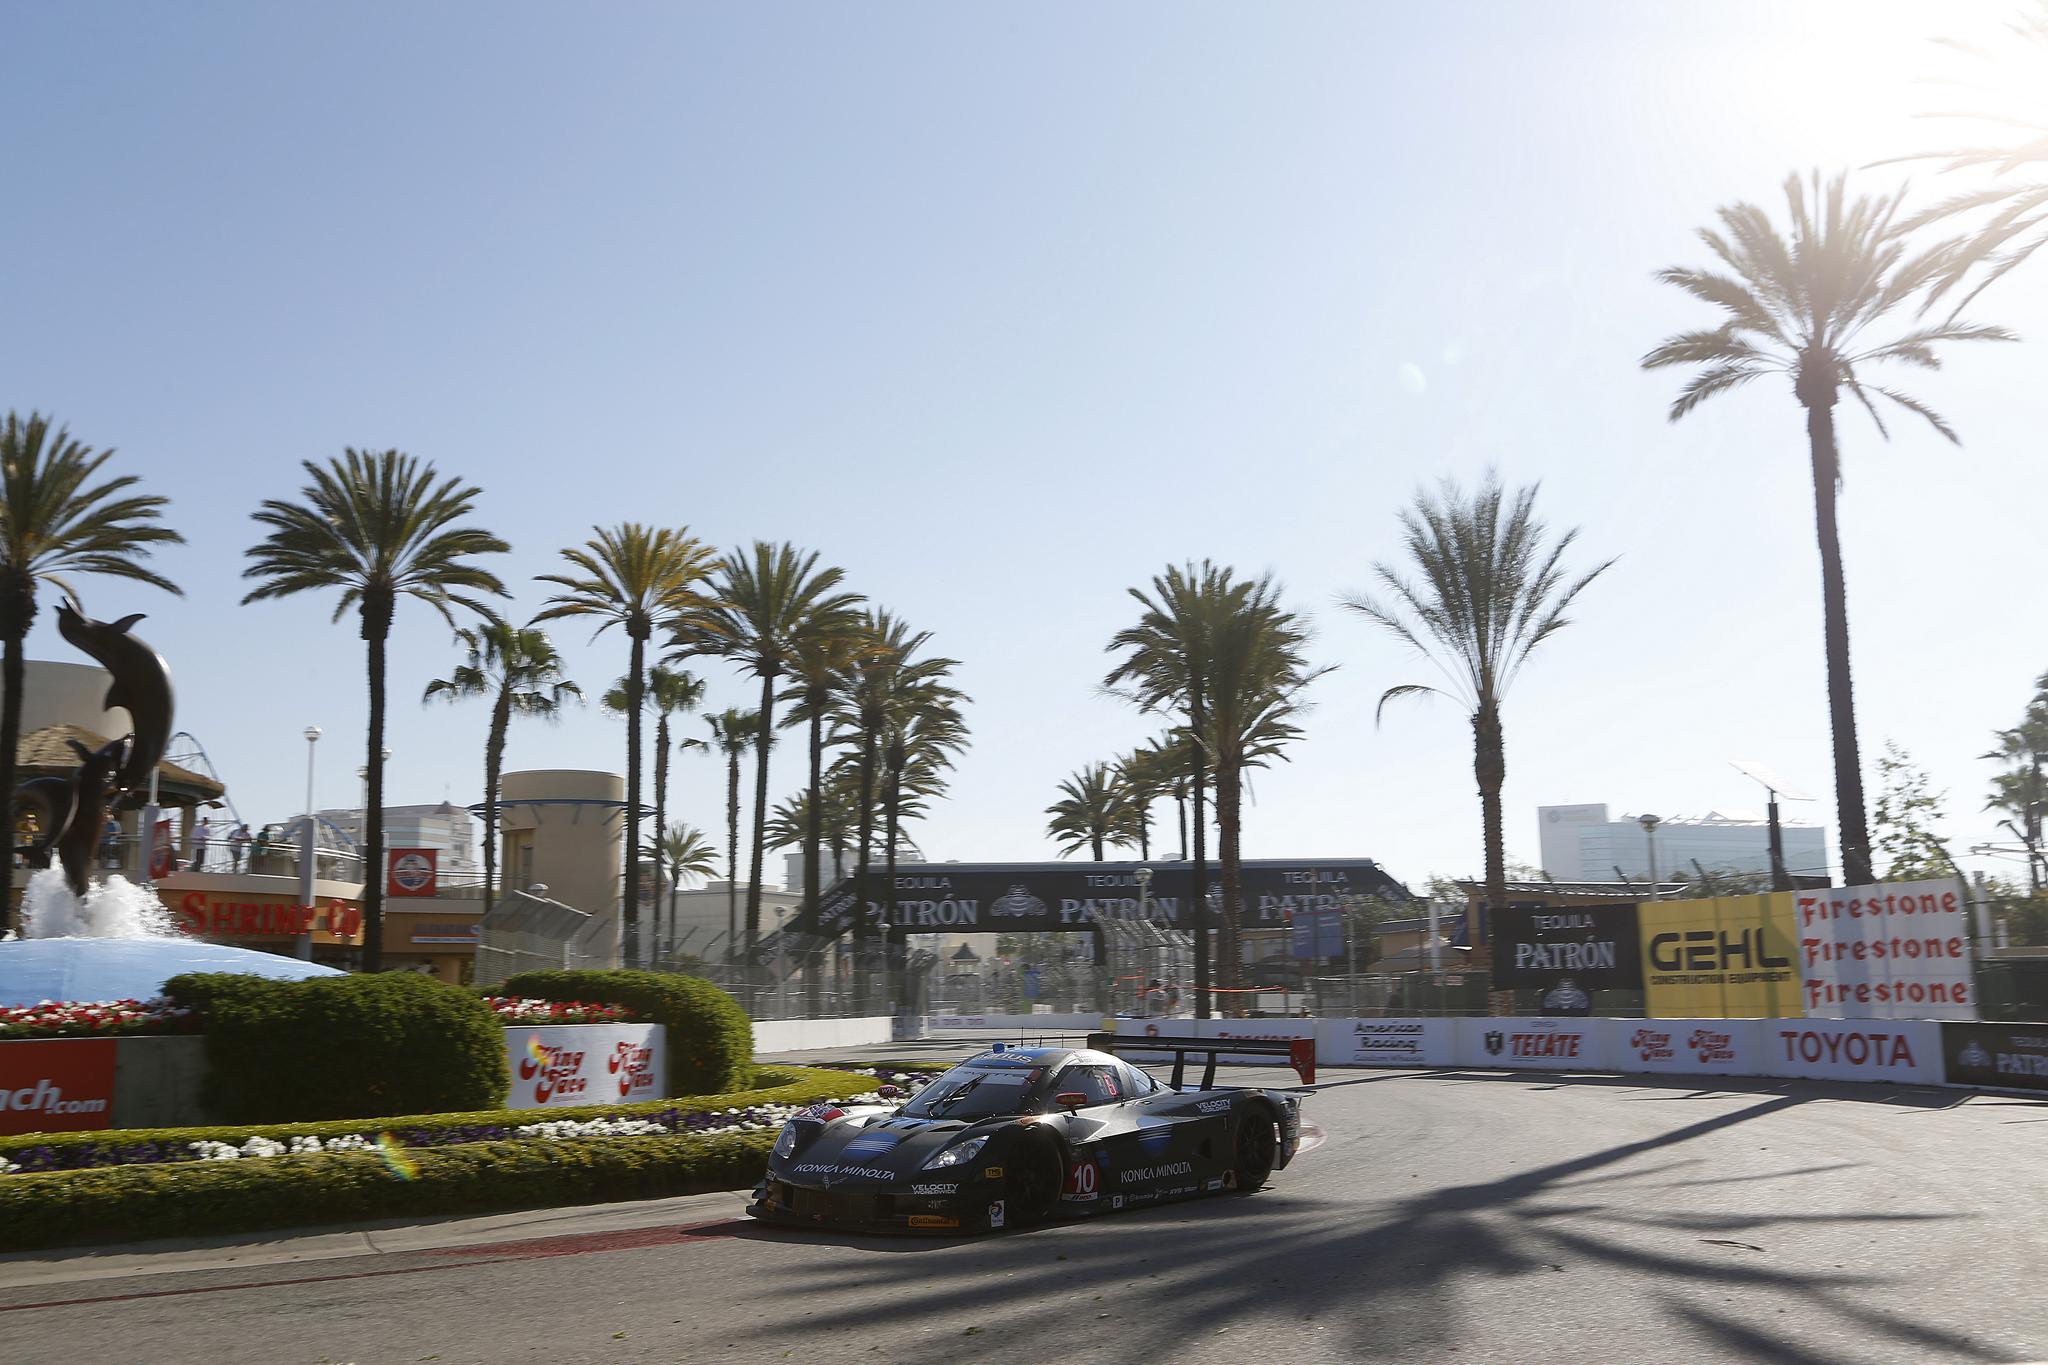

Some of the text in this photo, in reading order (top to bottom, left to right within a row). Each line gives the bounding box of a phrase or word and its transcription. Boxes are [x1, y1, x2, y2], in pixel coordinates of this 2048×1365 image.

[886, 877, 952, 889] EQUILA
[1798, 892, 1960, 927] Firestone
[1532, 914, 1596, 929] TEQUILA
[1514, 935, 1617, 970] PATRÓN
[1651, 928, 1790, 971] GEHL
[1802, 937, 1964, 968] Firestone
[1650, 972, 1792, 985] CONSTRUCTION EQUIPMENT
[1805, 979, 1969, 1009] Firestone
[1354, 1021, 1425, 1032] American
[1360, 1036, 1417, 1054] Racing
[1779, 1031, 1916, 1068] TOYOTA
[1196, 1099, 1230, 1109] VELOCITY
[793, 1163, 896, 1181] KONICA MINOLTA
[1074, 1163, 1095, 1194] 10
[1121, 1161, 1192, 1183] KONICA MINOLTA
[911, 1183, 960, 1191] VELOCITY
